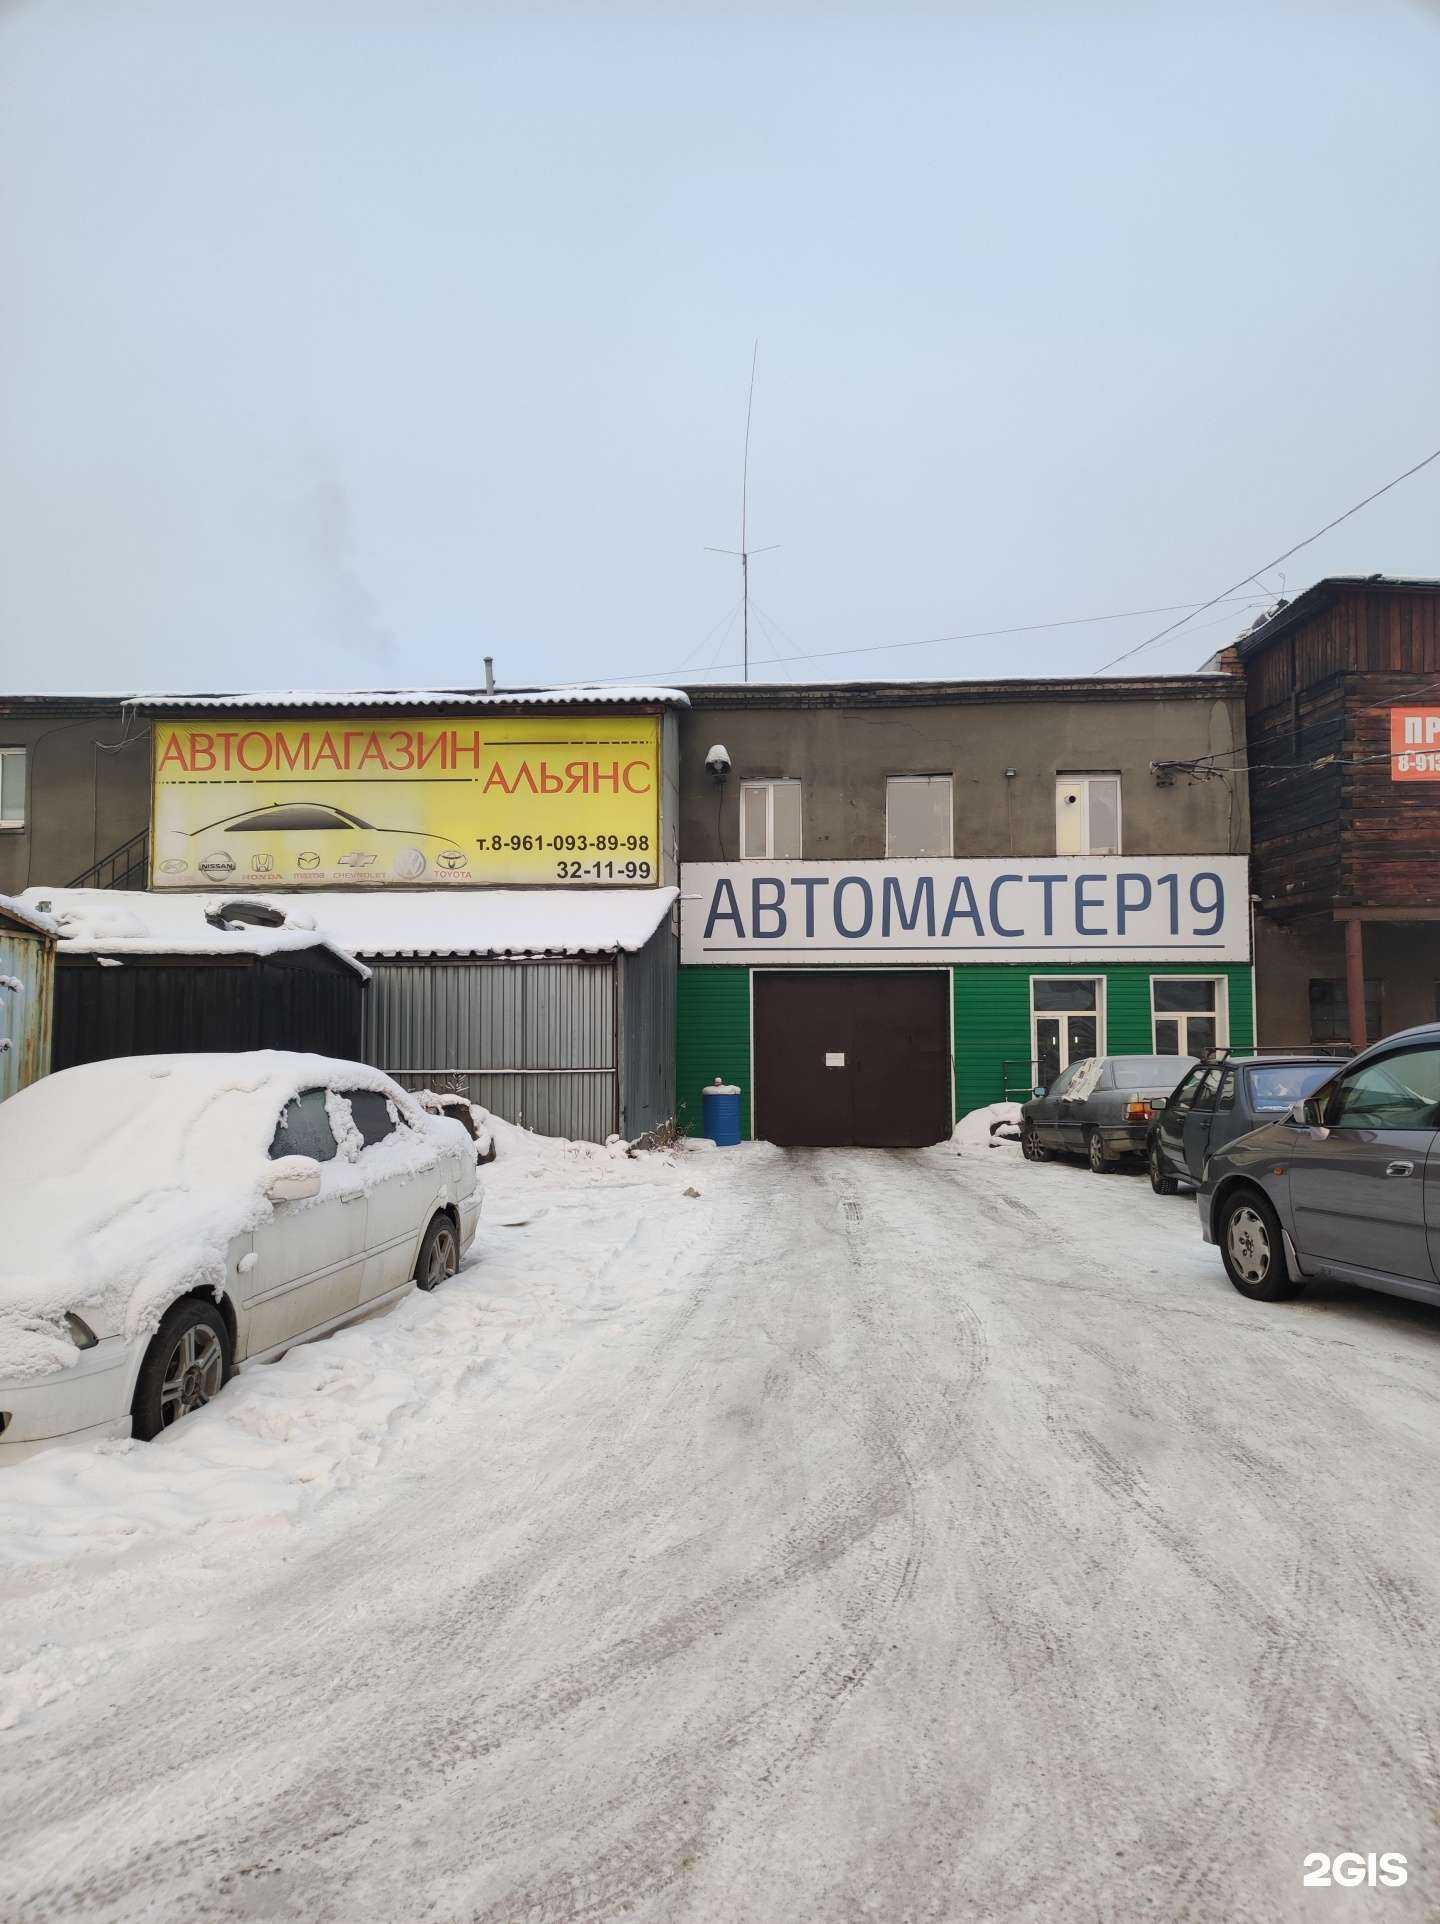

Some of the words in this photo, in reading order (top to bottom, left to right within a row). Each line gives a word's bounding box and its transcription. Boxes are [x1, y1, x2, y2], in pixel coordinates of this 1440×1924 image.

[158, 730, 480, 772] АВТОМАГАЗИН
[482, 760, 651, 794] АЛЬЯНС
[476, 835, 649, 851] т.8-961-093-89-98
[434, 870, 472, 879] TOYOTA
[556, 861, 651, 879] 32-11-99
[703, 872, 1226, 939] АВТОМАСТЕР19
